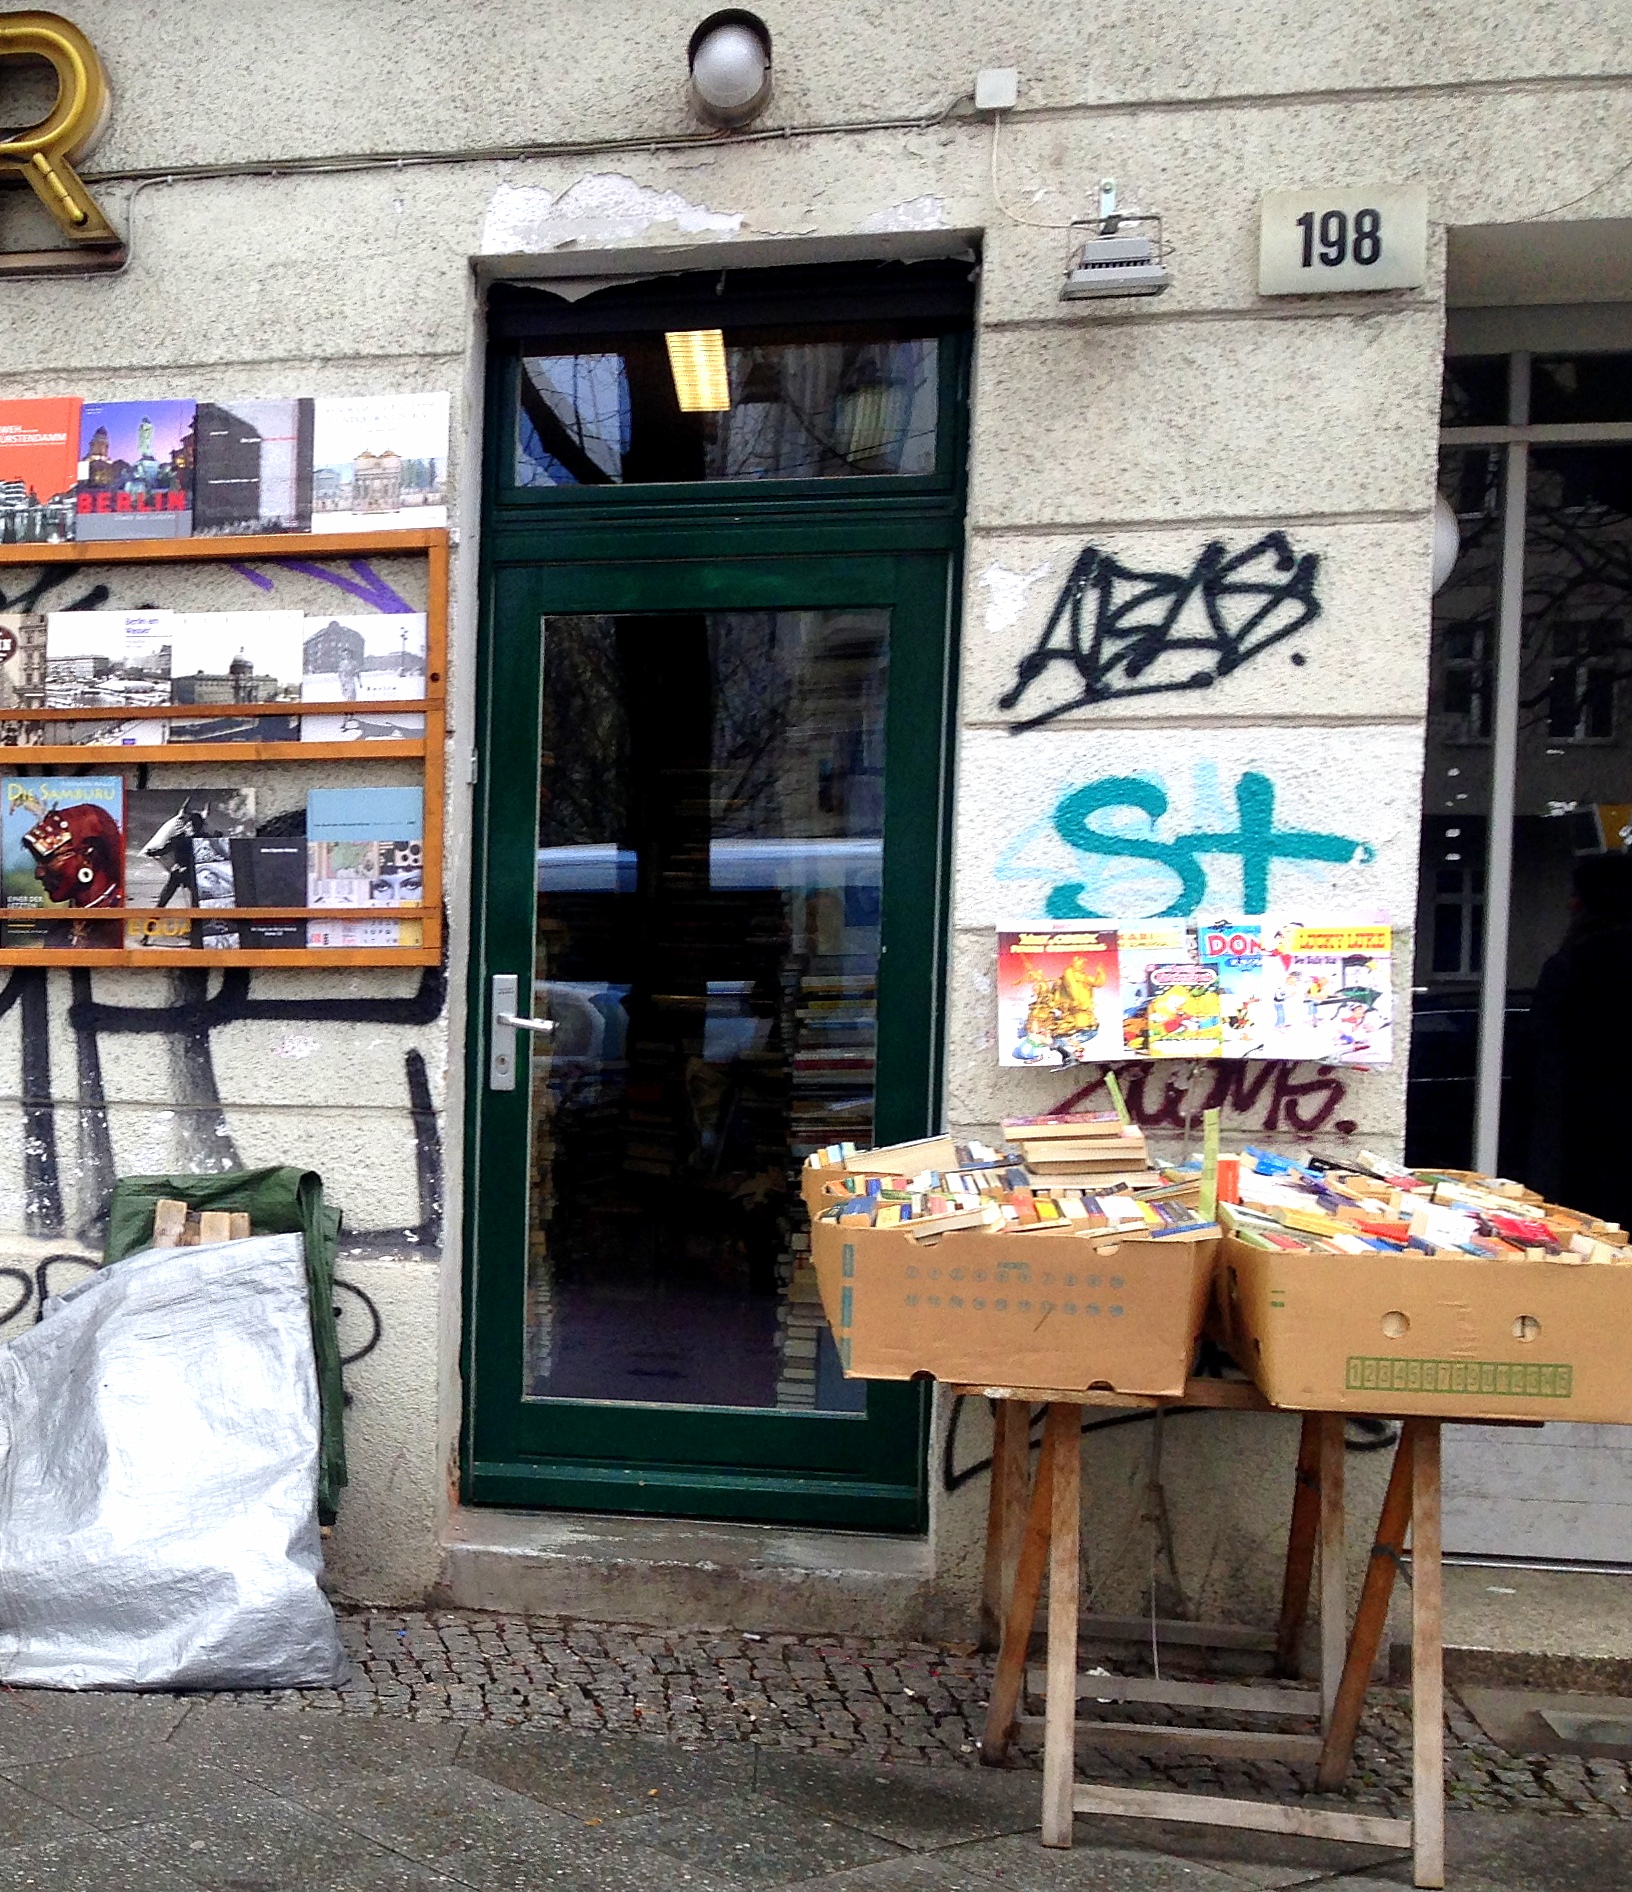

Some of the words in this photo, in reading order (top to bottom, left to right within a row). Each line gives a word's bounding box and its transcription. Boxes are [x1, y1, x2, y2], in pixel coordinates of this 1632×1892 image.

[1296, 208, 1382, 268] 198
[77, 491, 186, 514] BERLIN
[1299, 933, 1344, 949] LUCKY
